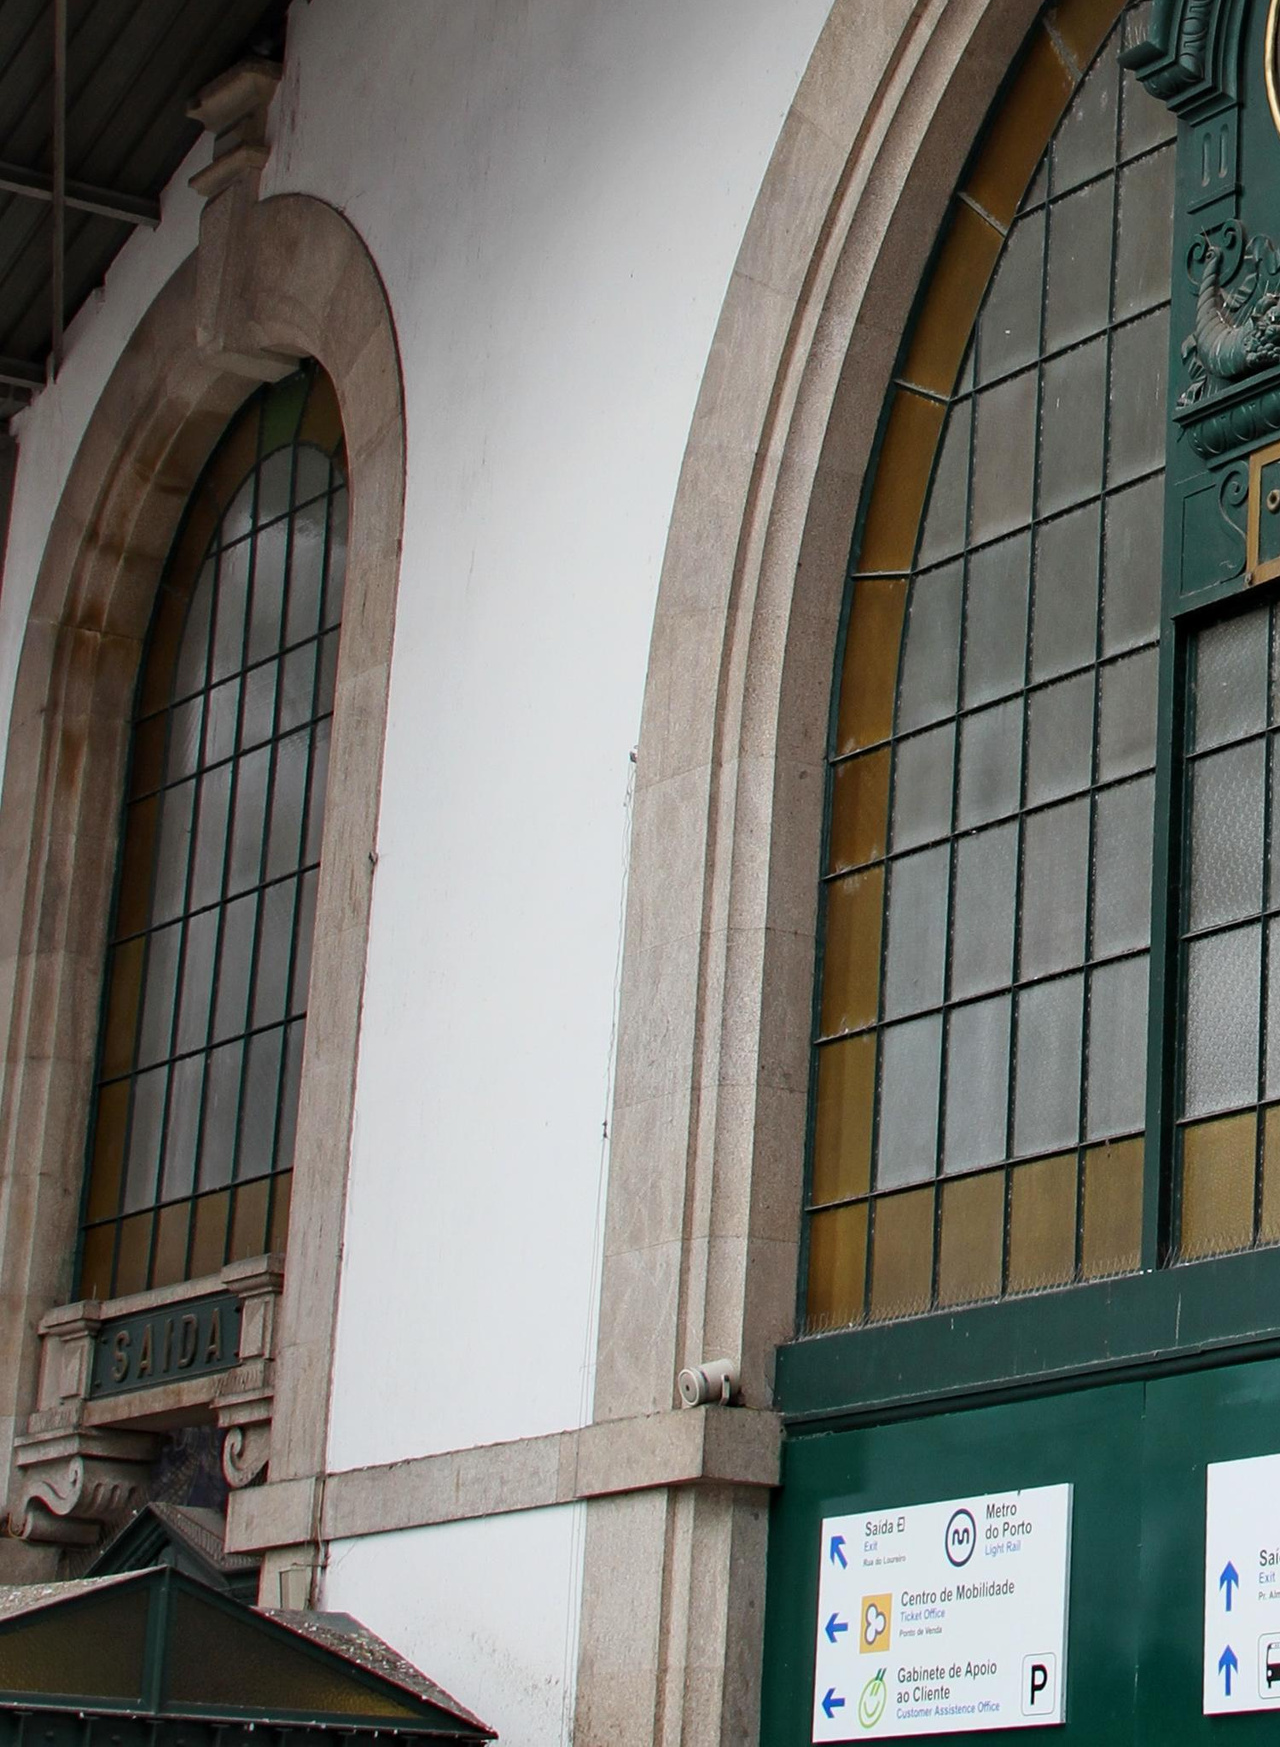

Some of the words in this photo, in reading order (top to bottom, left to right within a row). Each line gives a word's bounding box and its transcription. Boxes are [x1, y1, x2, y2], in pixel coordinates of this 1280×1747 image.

[112, 1307, 223, 1383] SAIDA
[985, 1503, 1017, 1520] Metro
[864, 1518, 894, 1537] Saída
[985, 1524, 999, 1539] do
[1002, 1520, 1032, 1537] Porto
[864, 1540, 878, 1552] Exit
[985, 1542, 1005, 1557] Light
[1006, 1540, 1021, 1552] Rail
[1259, 1571, 1276, 1584] Exit
[901, 1591, 937, 1607] Centro
[940, 1586, 953, 1603] de
[956, 1579, 1015, 1600] Mobilidade
[900, 1610, 922, 1622] Ticket
[923, 1608, 946, 1620] Office
[897, 1667, 946, 1684] Gabinete
[949, 1663, 963, 1679] de
[964, 1661, 998, 1680] Apoio
[1030, 1664, 1048, 1706] P
[896, 1692, 910, 1704] ao
[912, 1686, 951, 1703] Cliente
[896, 1705, 932, 1719] Customer
[977, 1700, 1001, 1712] Office
